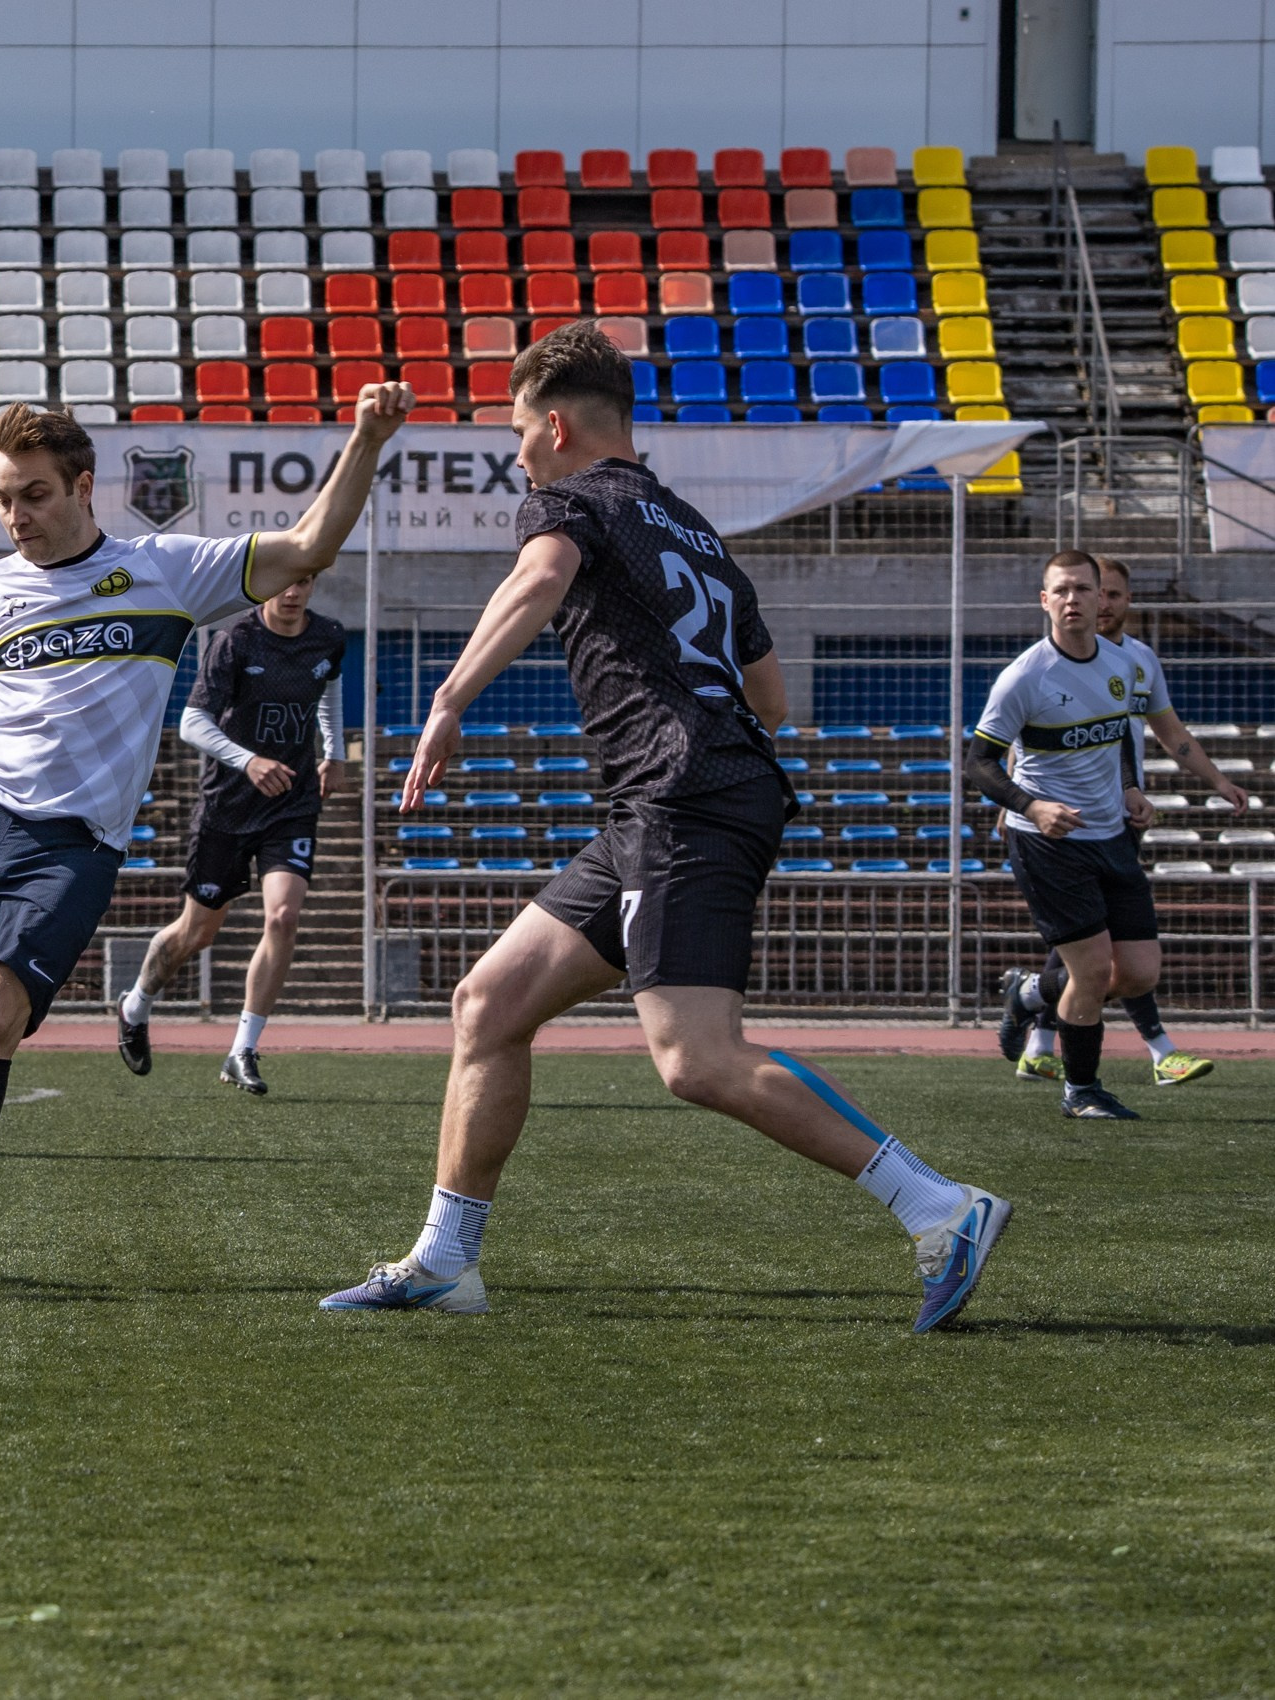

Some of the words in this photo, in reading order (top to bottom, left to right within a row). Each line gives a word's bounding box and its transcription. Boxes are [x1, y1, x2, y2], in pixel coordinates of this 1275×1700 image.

[659, 551, 744, 689] 27
[438, 1189, 462, 1204] NIKE
[462, 1199, 488, 1210] PRO
